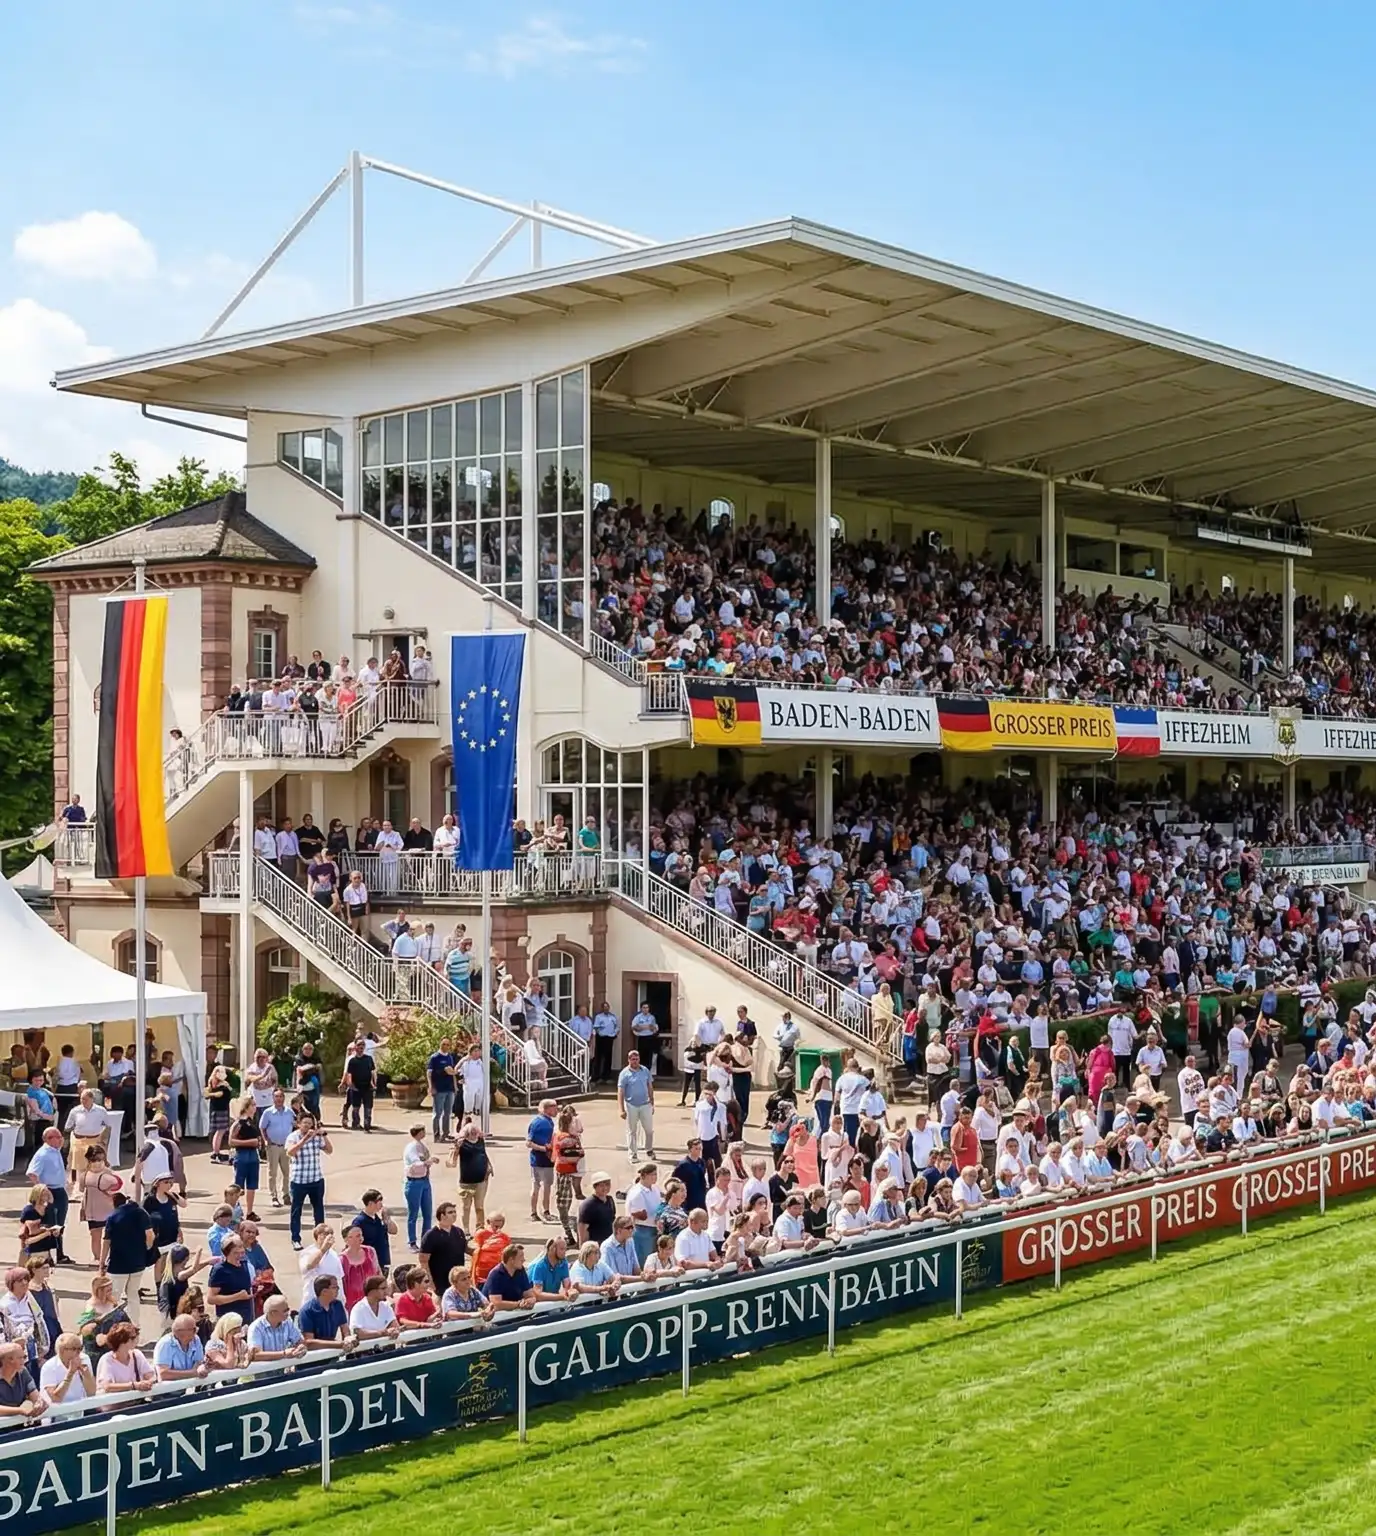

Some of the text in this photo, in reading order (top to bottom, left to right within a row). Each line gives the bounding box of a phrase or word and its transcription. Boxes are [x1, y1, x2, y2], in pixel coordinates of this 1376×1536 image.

[769, 701, 932, 732] BADEN-BADEN
[994, 713, 1111, 738] GROSSER PREIS
[1165, 721, 1251, 745] IFFEZHEIM
[1018, 1204, 1142, 1265] GROSSER
[1152, 1184, 1217, 1229] PREIS
[1232, 1157, 1332, 1211] GROSSER
